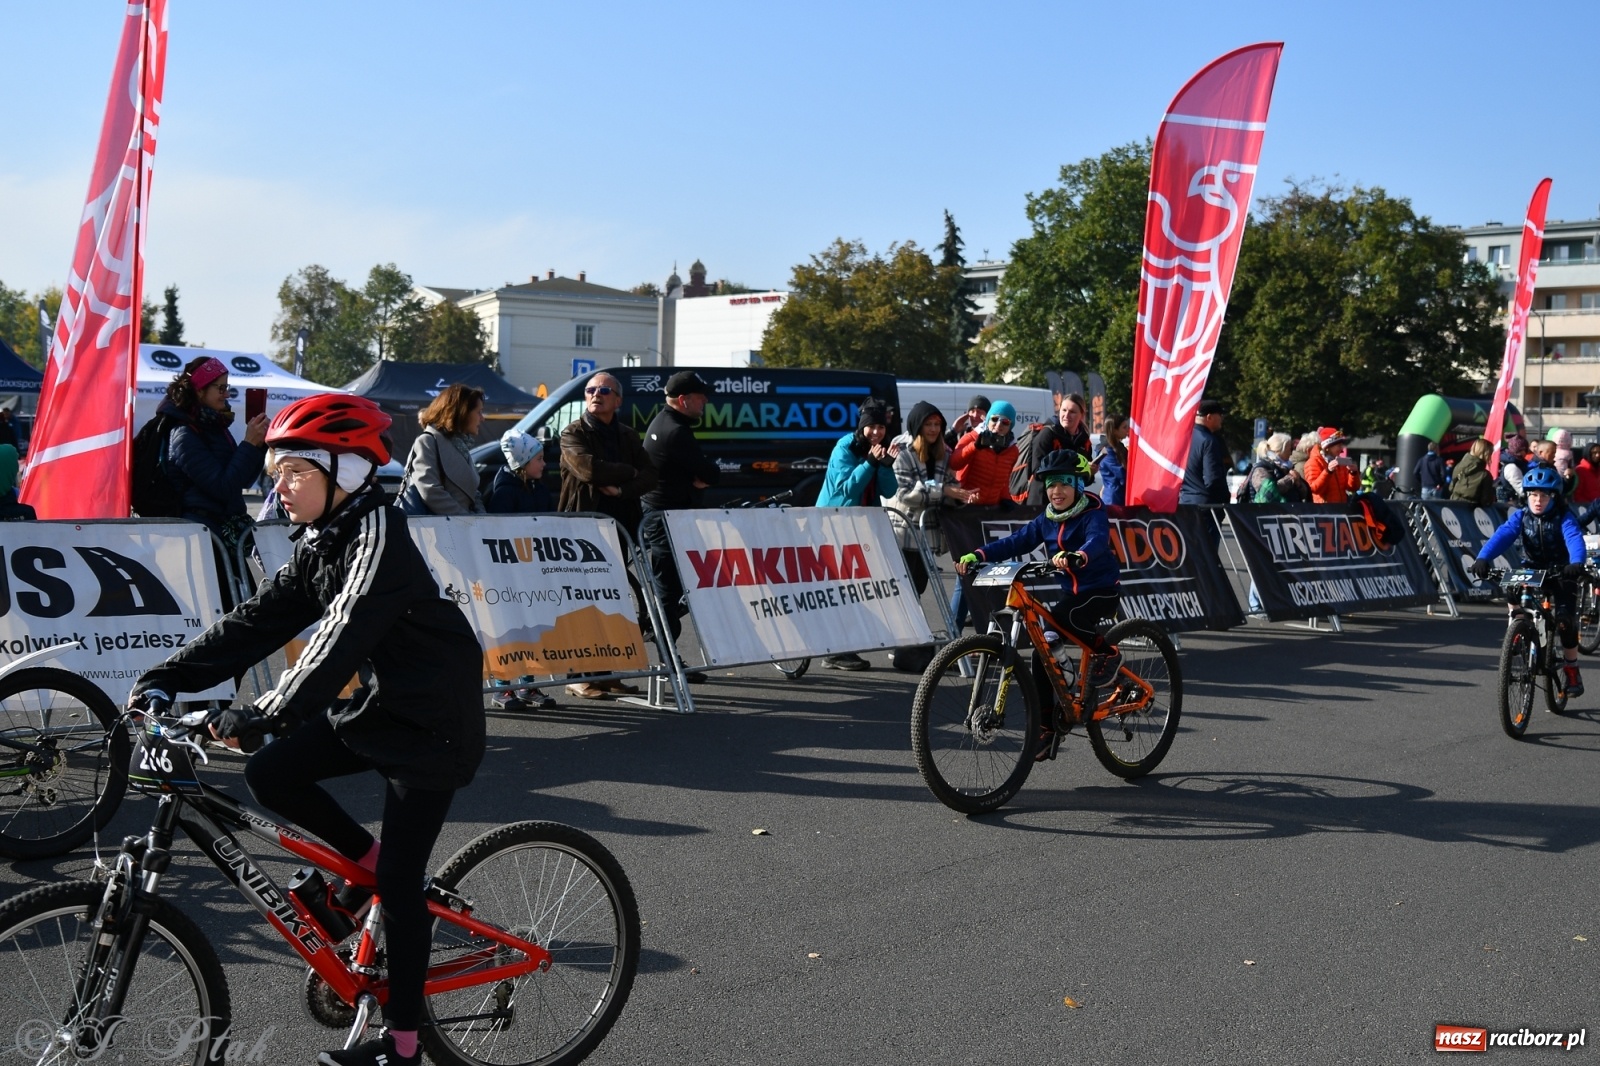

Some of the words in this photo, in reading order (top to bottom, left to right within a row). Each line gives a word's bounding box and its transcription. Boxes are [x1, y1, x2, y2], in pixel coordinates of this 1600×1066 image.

[482, 537, 577, 564] TAURUS
[686, 543, 872, 590] YAKIMA
[750, 595, 793, 621] TAKE
[793, 588, 839, 613] MORE
[840, 577, 900, 605] FRIENDS
[94, 632, 187, 656] jedziesz
[542, 643, 637, 661] taurus.info.pl
[240, 811, 302, 841] RAPTOR
[213, 835, 326, 955] UNIBIKE
